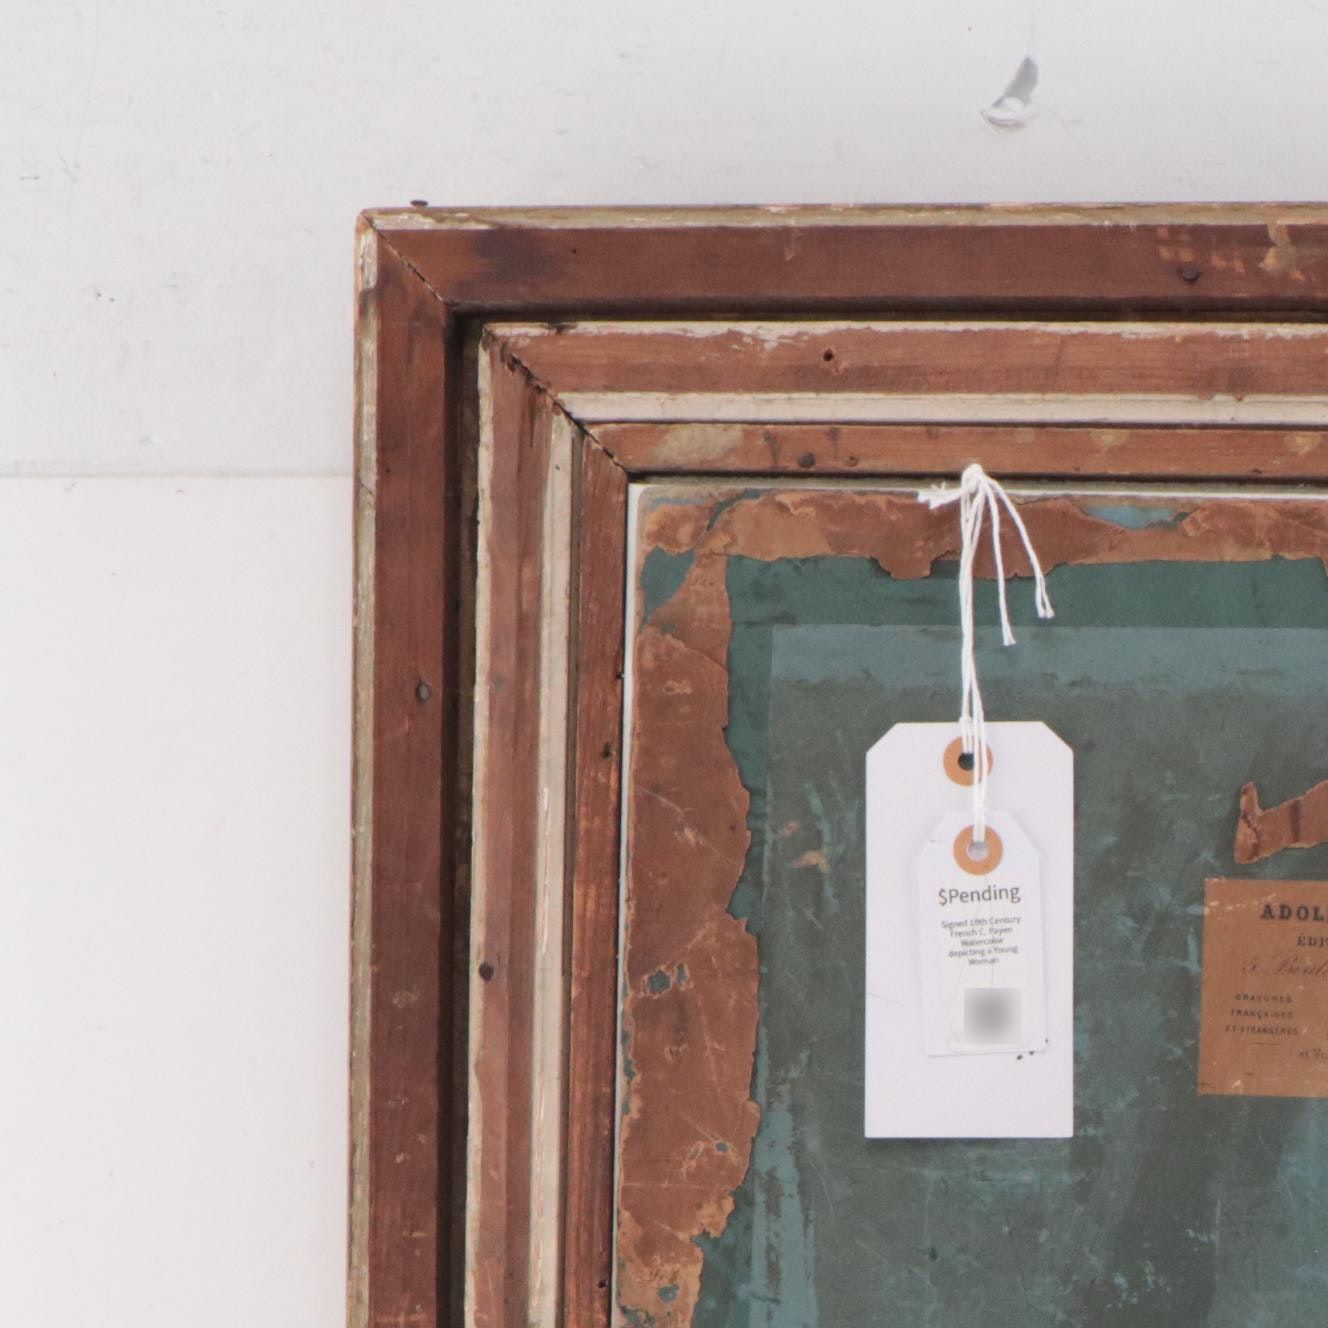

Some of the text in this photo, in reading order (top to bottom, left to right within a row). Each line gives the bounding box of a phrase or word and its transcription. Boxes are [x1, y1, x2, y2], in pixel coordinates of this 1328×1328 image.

[938, 885, 1021, 906] $Pending
[941, 916, 1021, 929] Signed 19th Century
[950, 930, 977, 938] French
[960, 937, 1004, 947] Watercolor
[948, 948, 986, 958] depicting
[993, 945, 1019, 955] Young
[968, 957, 999, 966] Woman
